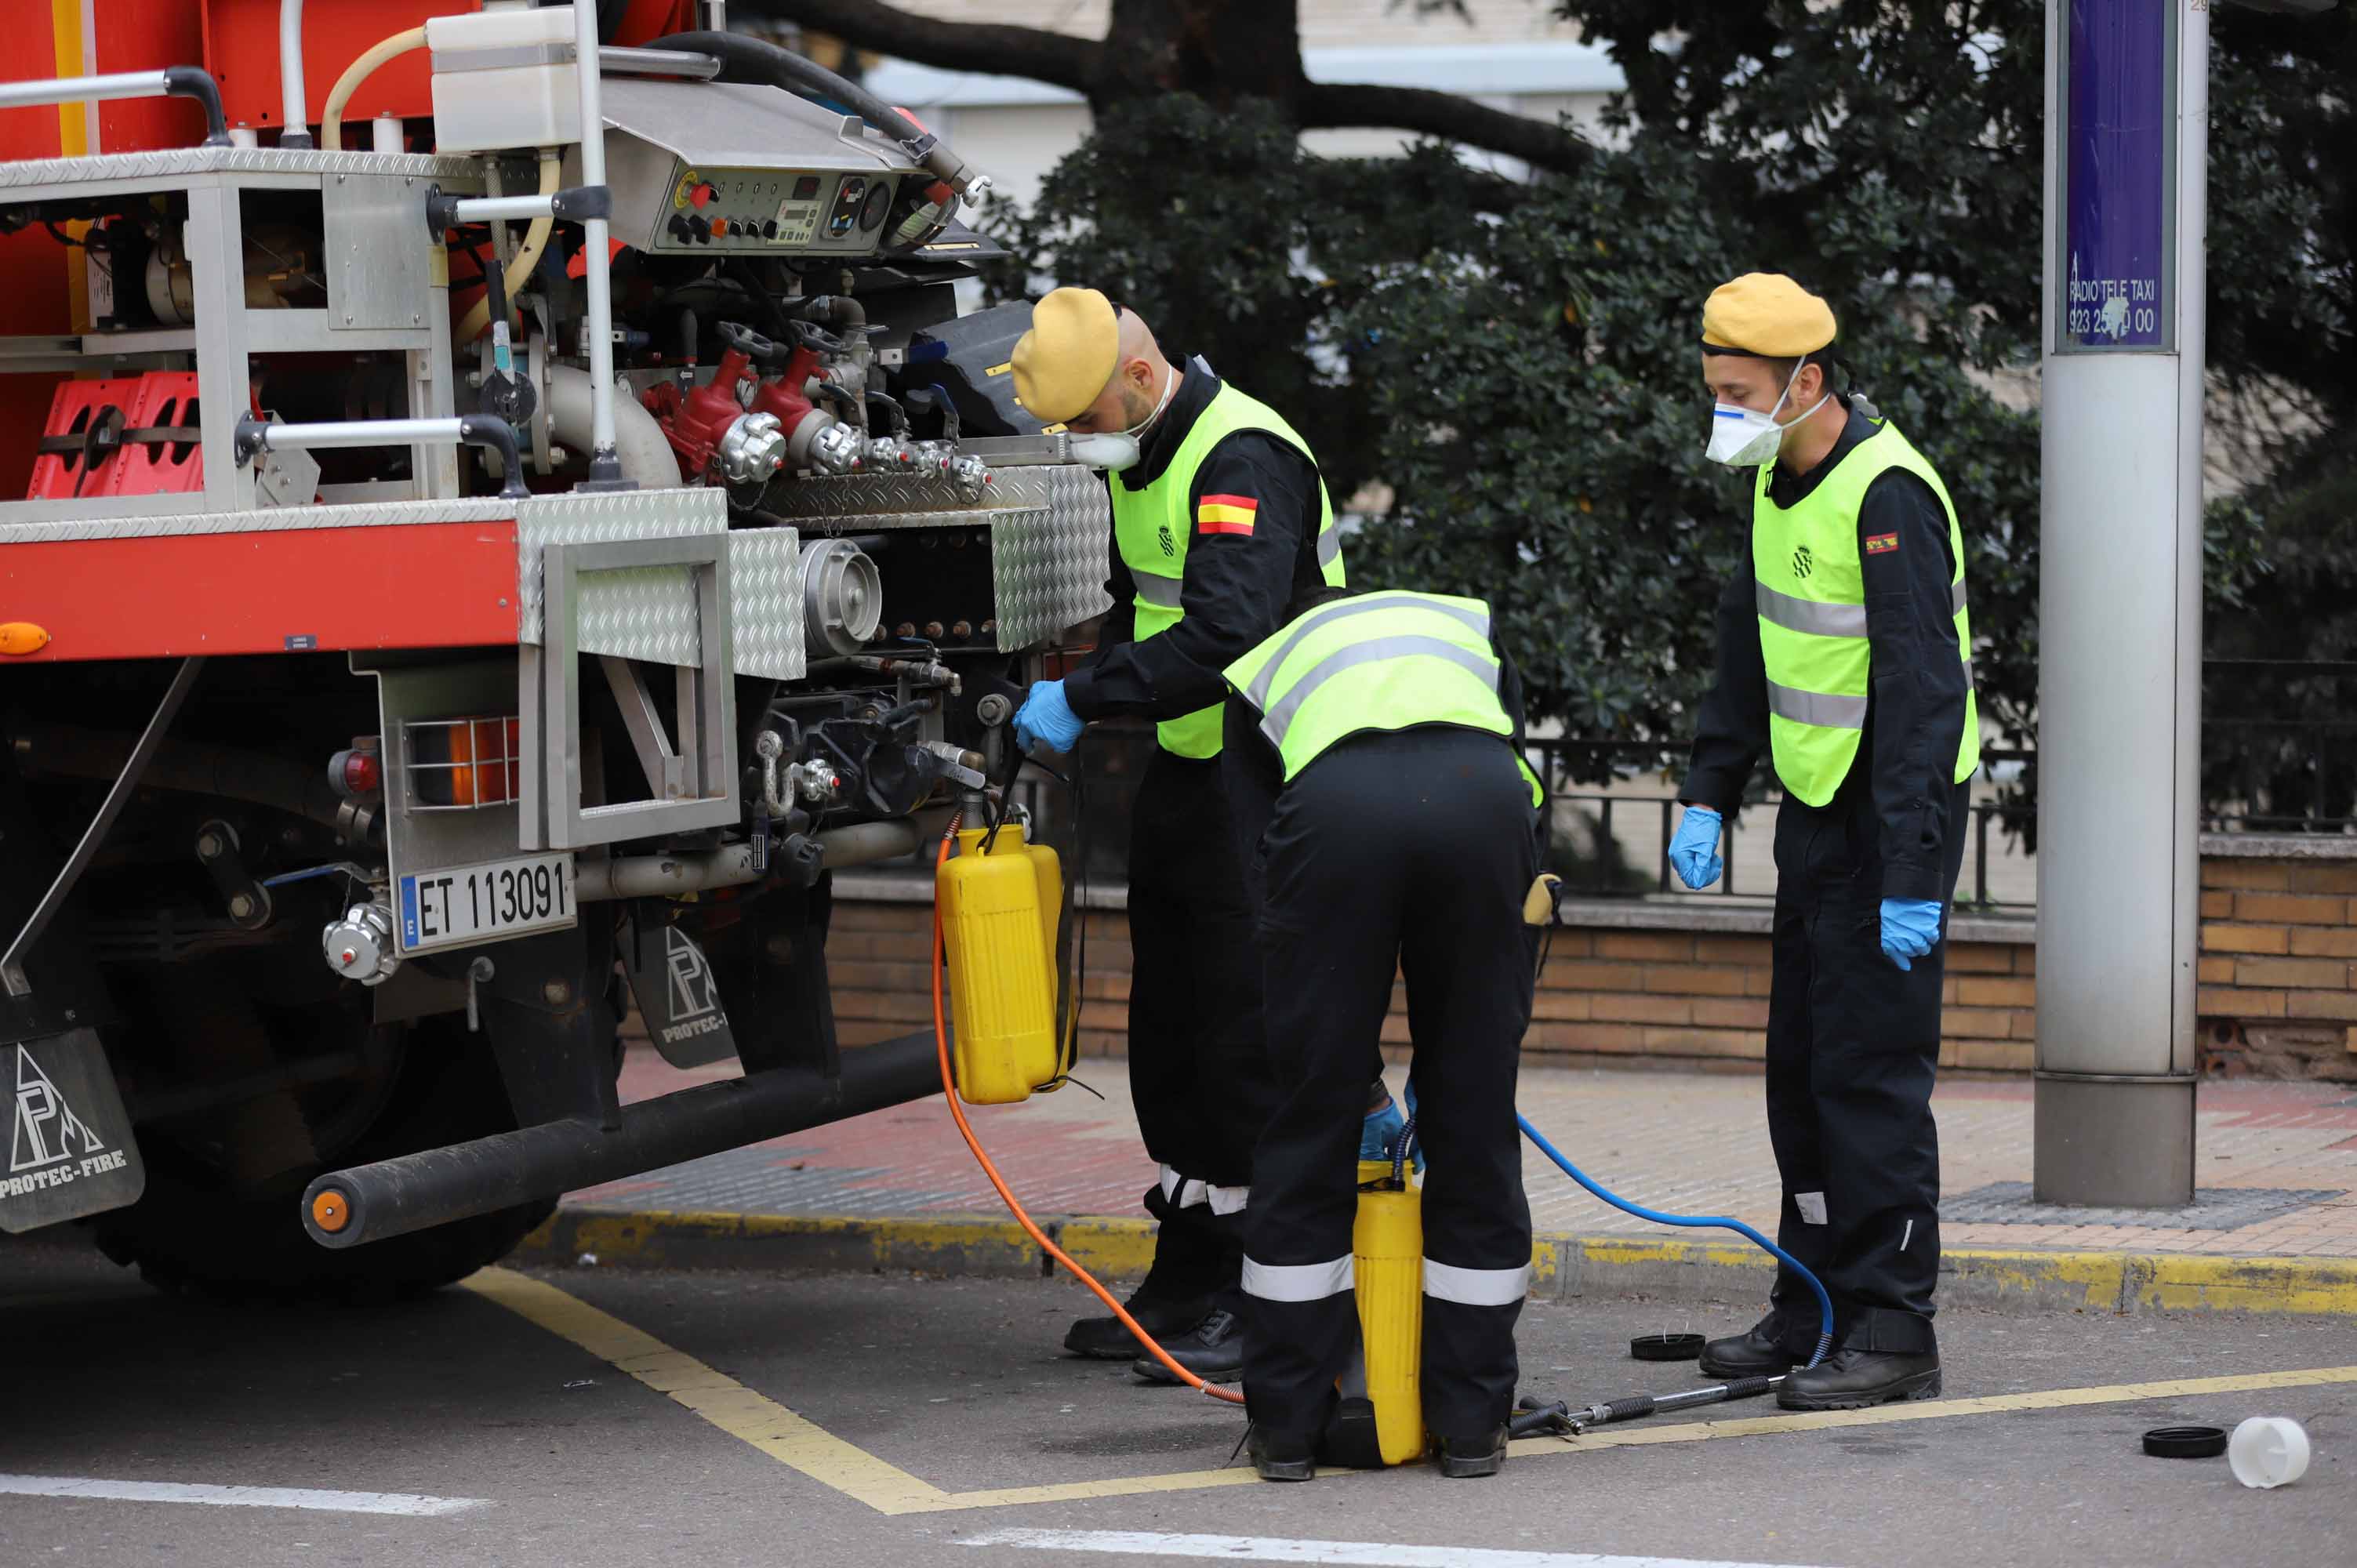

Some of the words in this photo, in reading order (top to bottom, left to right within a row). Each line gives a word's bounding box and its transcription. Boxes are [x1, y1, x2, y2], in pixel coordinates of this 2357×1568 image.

[2070, 280, 2098, 302] RADIO
[2101, 279, 2127, 301] TELE
[2130, 279, 2155, 301] TAXI
[2070, 309, 2090, 333] 923
[2135, 308, 2154, 333] 00
[419, 877, 453, 937] ET
[468, 862, 565, 929] 113091
[407, 919, 415, 935] E
[662, 1012, 728, 1044] PROTEC-
[0, 1149, 127, 1199] PROTEC-FIRE
